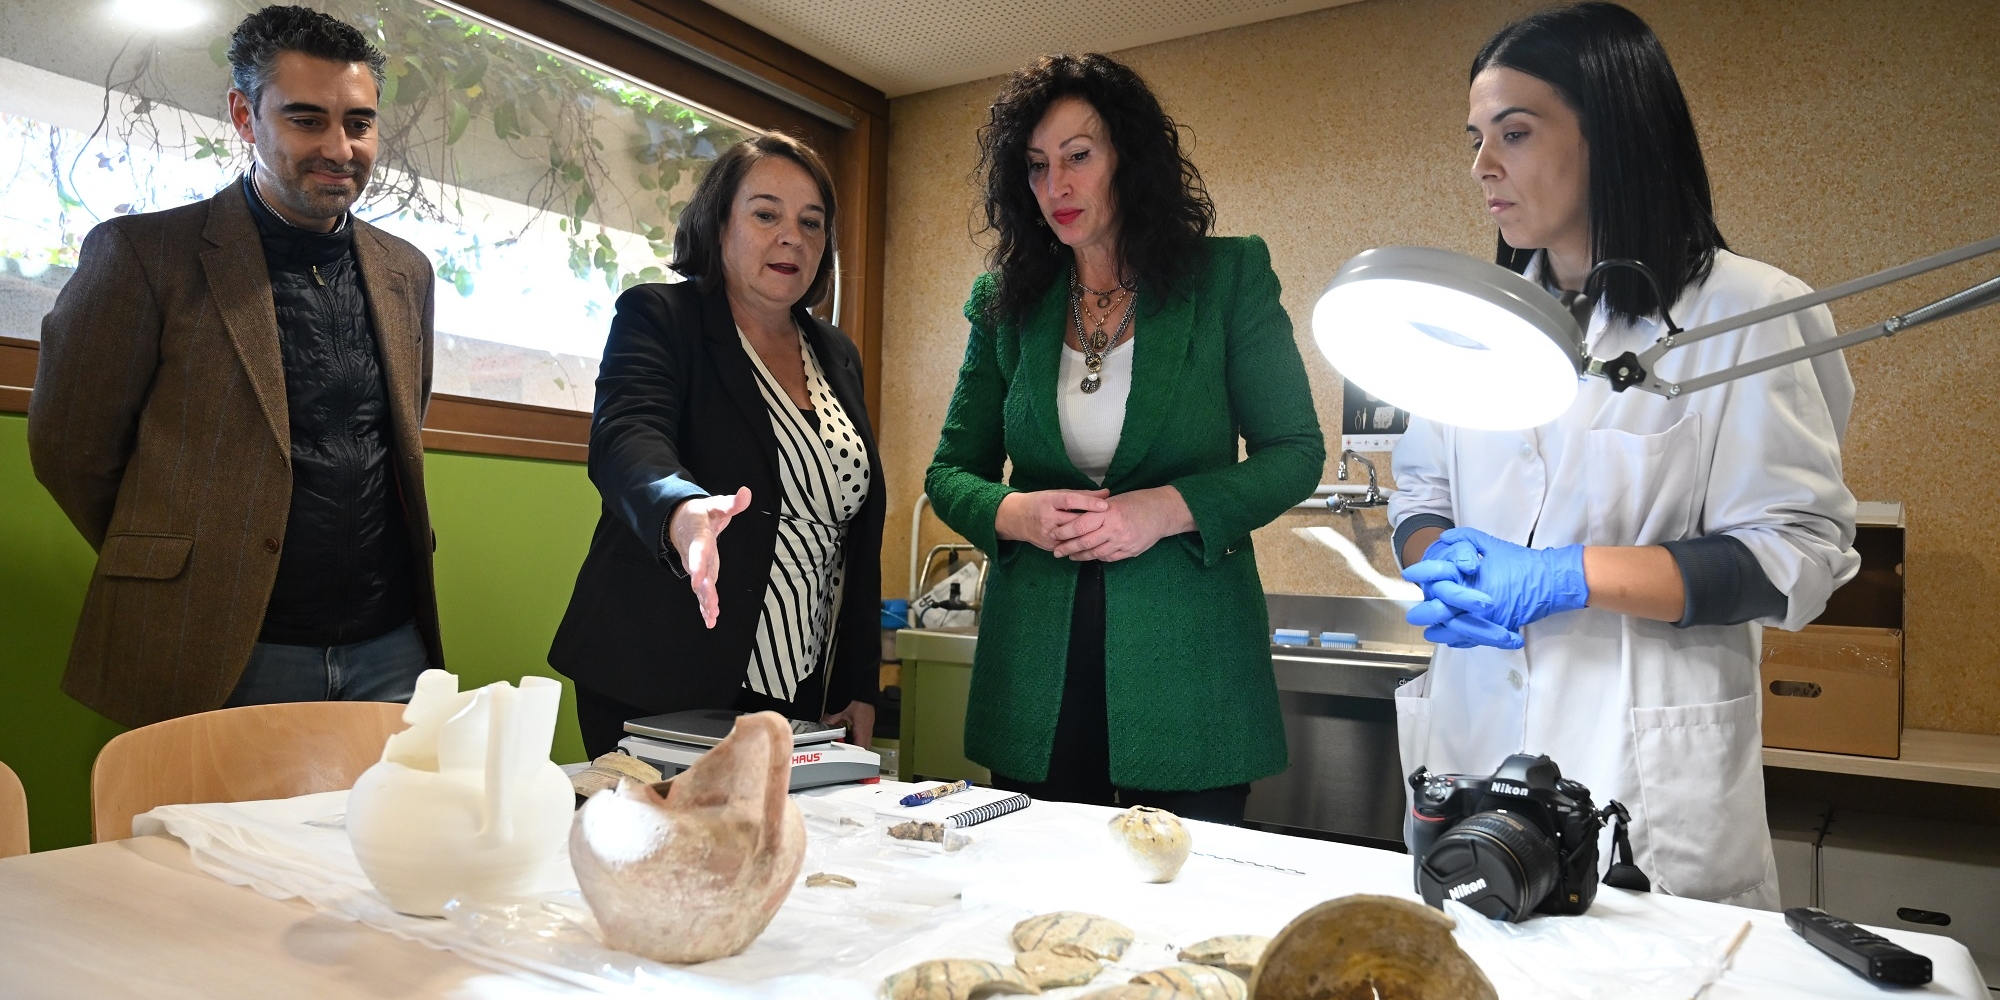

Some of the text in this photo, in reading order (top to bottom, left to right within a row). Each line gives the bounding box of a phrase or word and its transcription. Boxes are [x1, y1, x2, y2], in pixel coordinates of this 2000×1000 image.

[791, 753, 821, 764] HAUS
[1490, 781, 1529, 797] Nikon
[1448, 877, 1487, 901] Nikon
